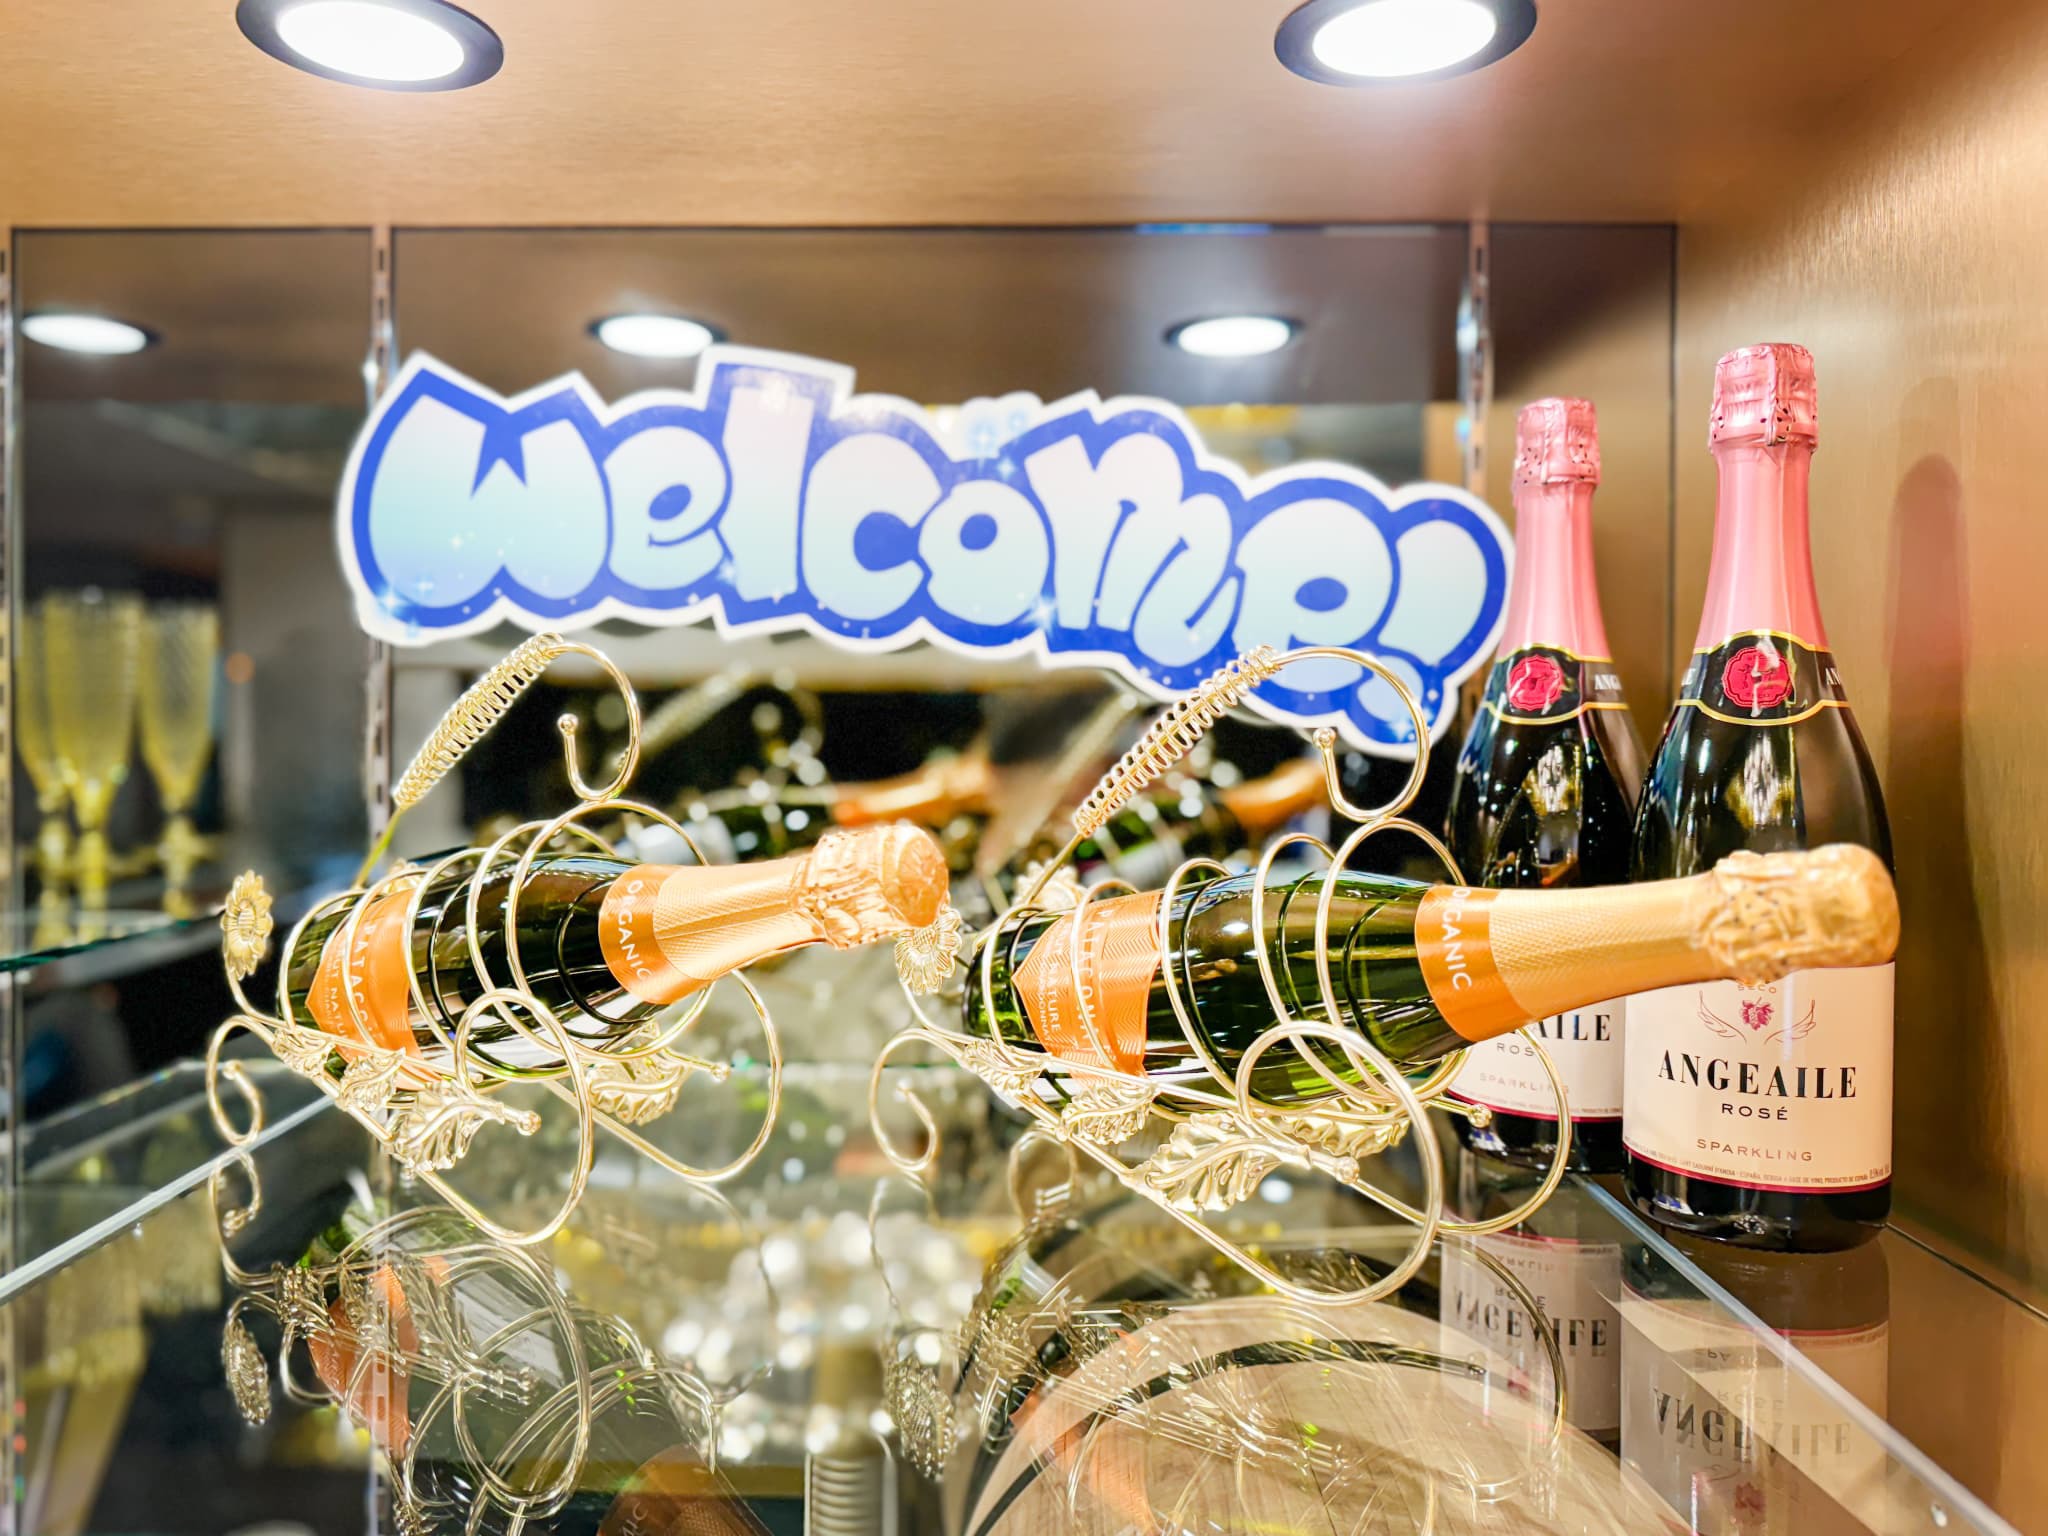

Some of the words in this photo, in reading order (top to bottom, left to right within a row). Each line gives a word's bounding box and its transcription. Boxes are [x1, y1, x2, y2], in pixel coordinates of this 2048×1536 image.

[617, 879, 653, 980] ORGANIC
[1496, 1041, 1536, 1057] ROS
[1657, 1049, 1857, 1100] ANGEAILE
[1721, 1103, 1788, 1121] ROSÉ
[1696, 1138, 1813, 1162] SPARKLING
